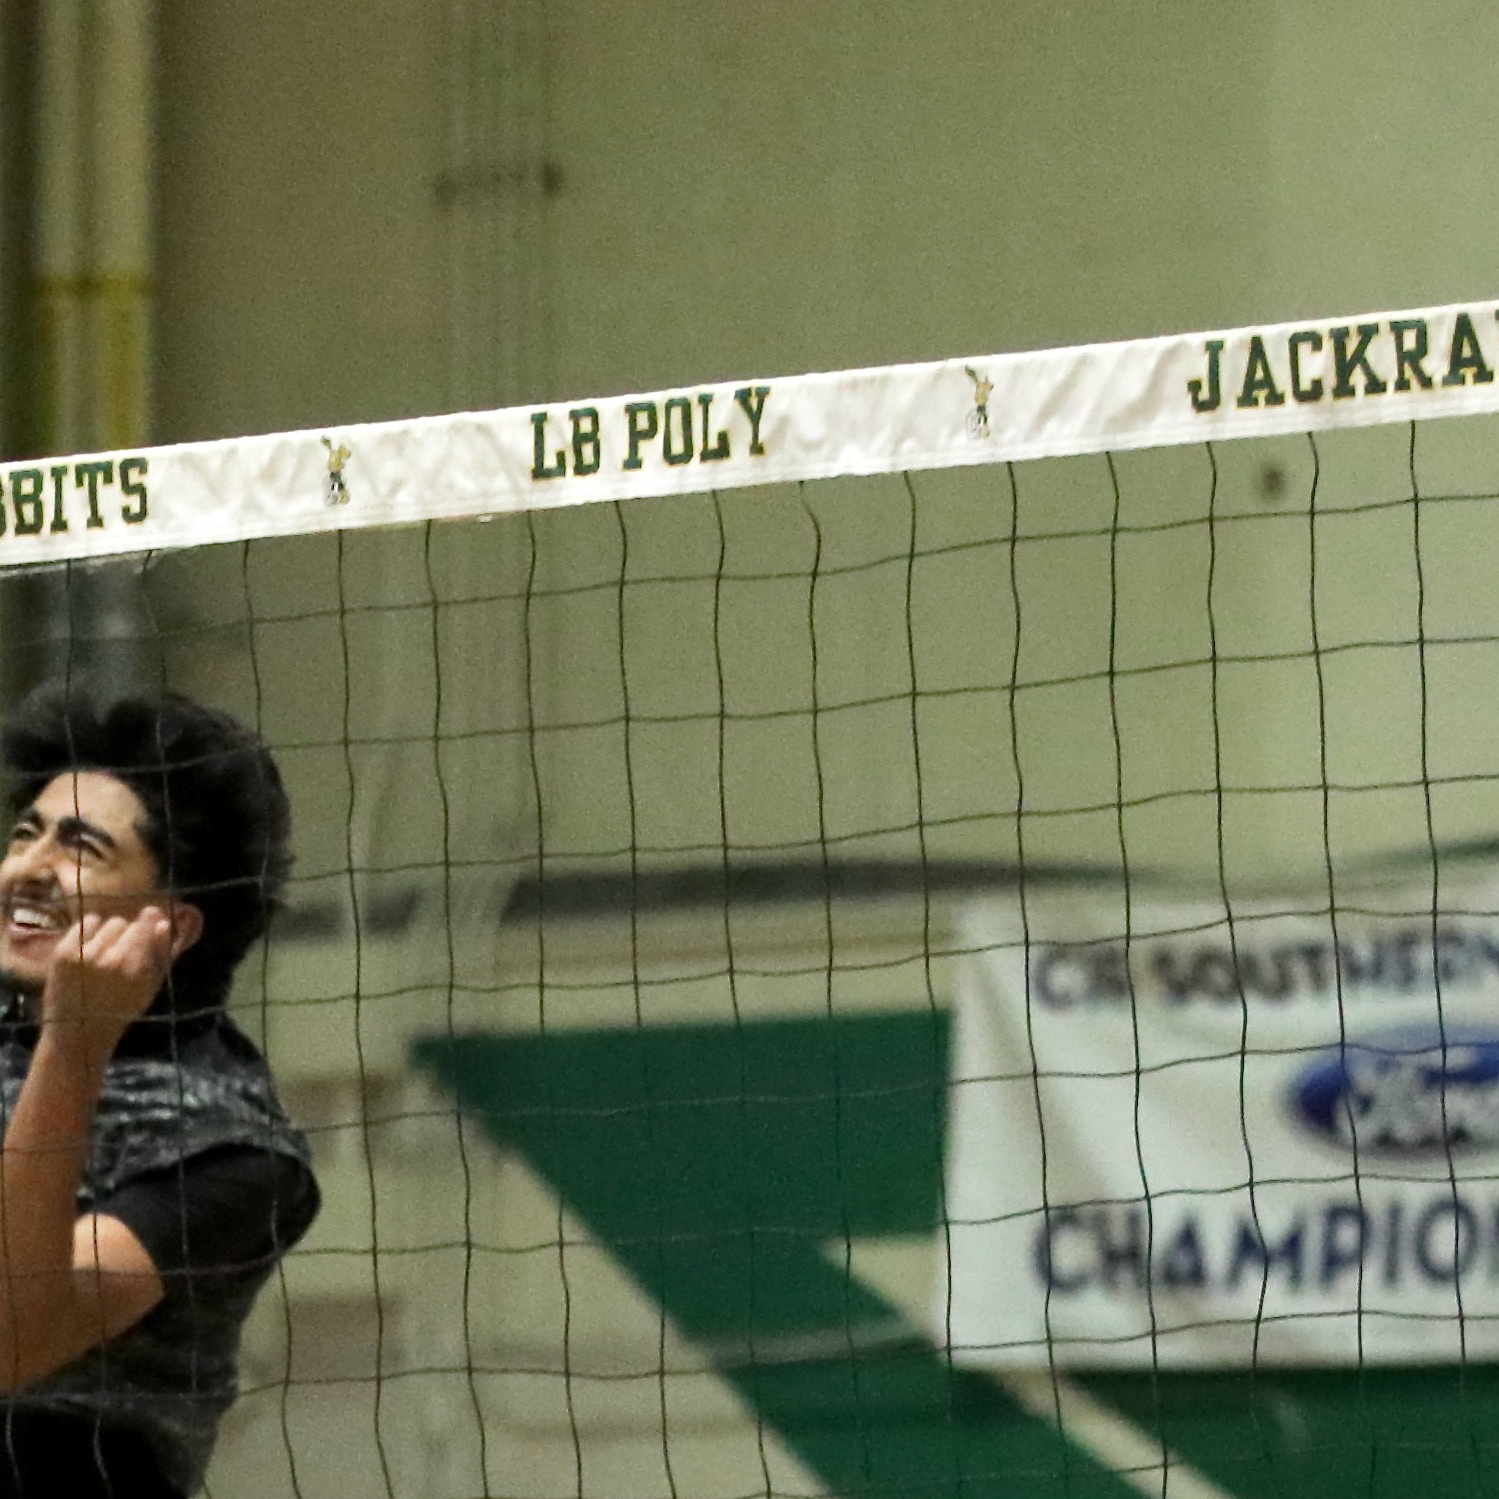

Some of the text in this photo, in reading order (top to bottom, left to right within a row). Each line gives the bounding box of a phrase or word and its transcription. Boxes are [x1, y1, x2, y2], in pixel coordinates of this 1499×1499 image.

[1186, 309, 1499, 413] JACKRA
[530, 385, 771, 480] LB POLY
